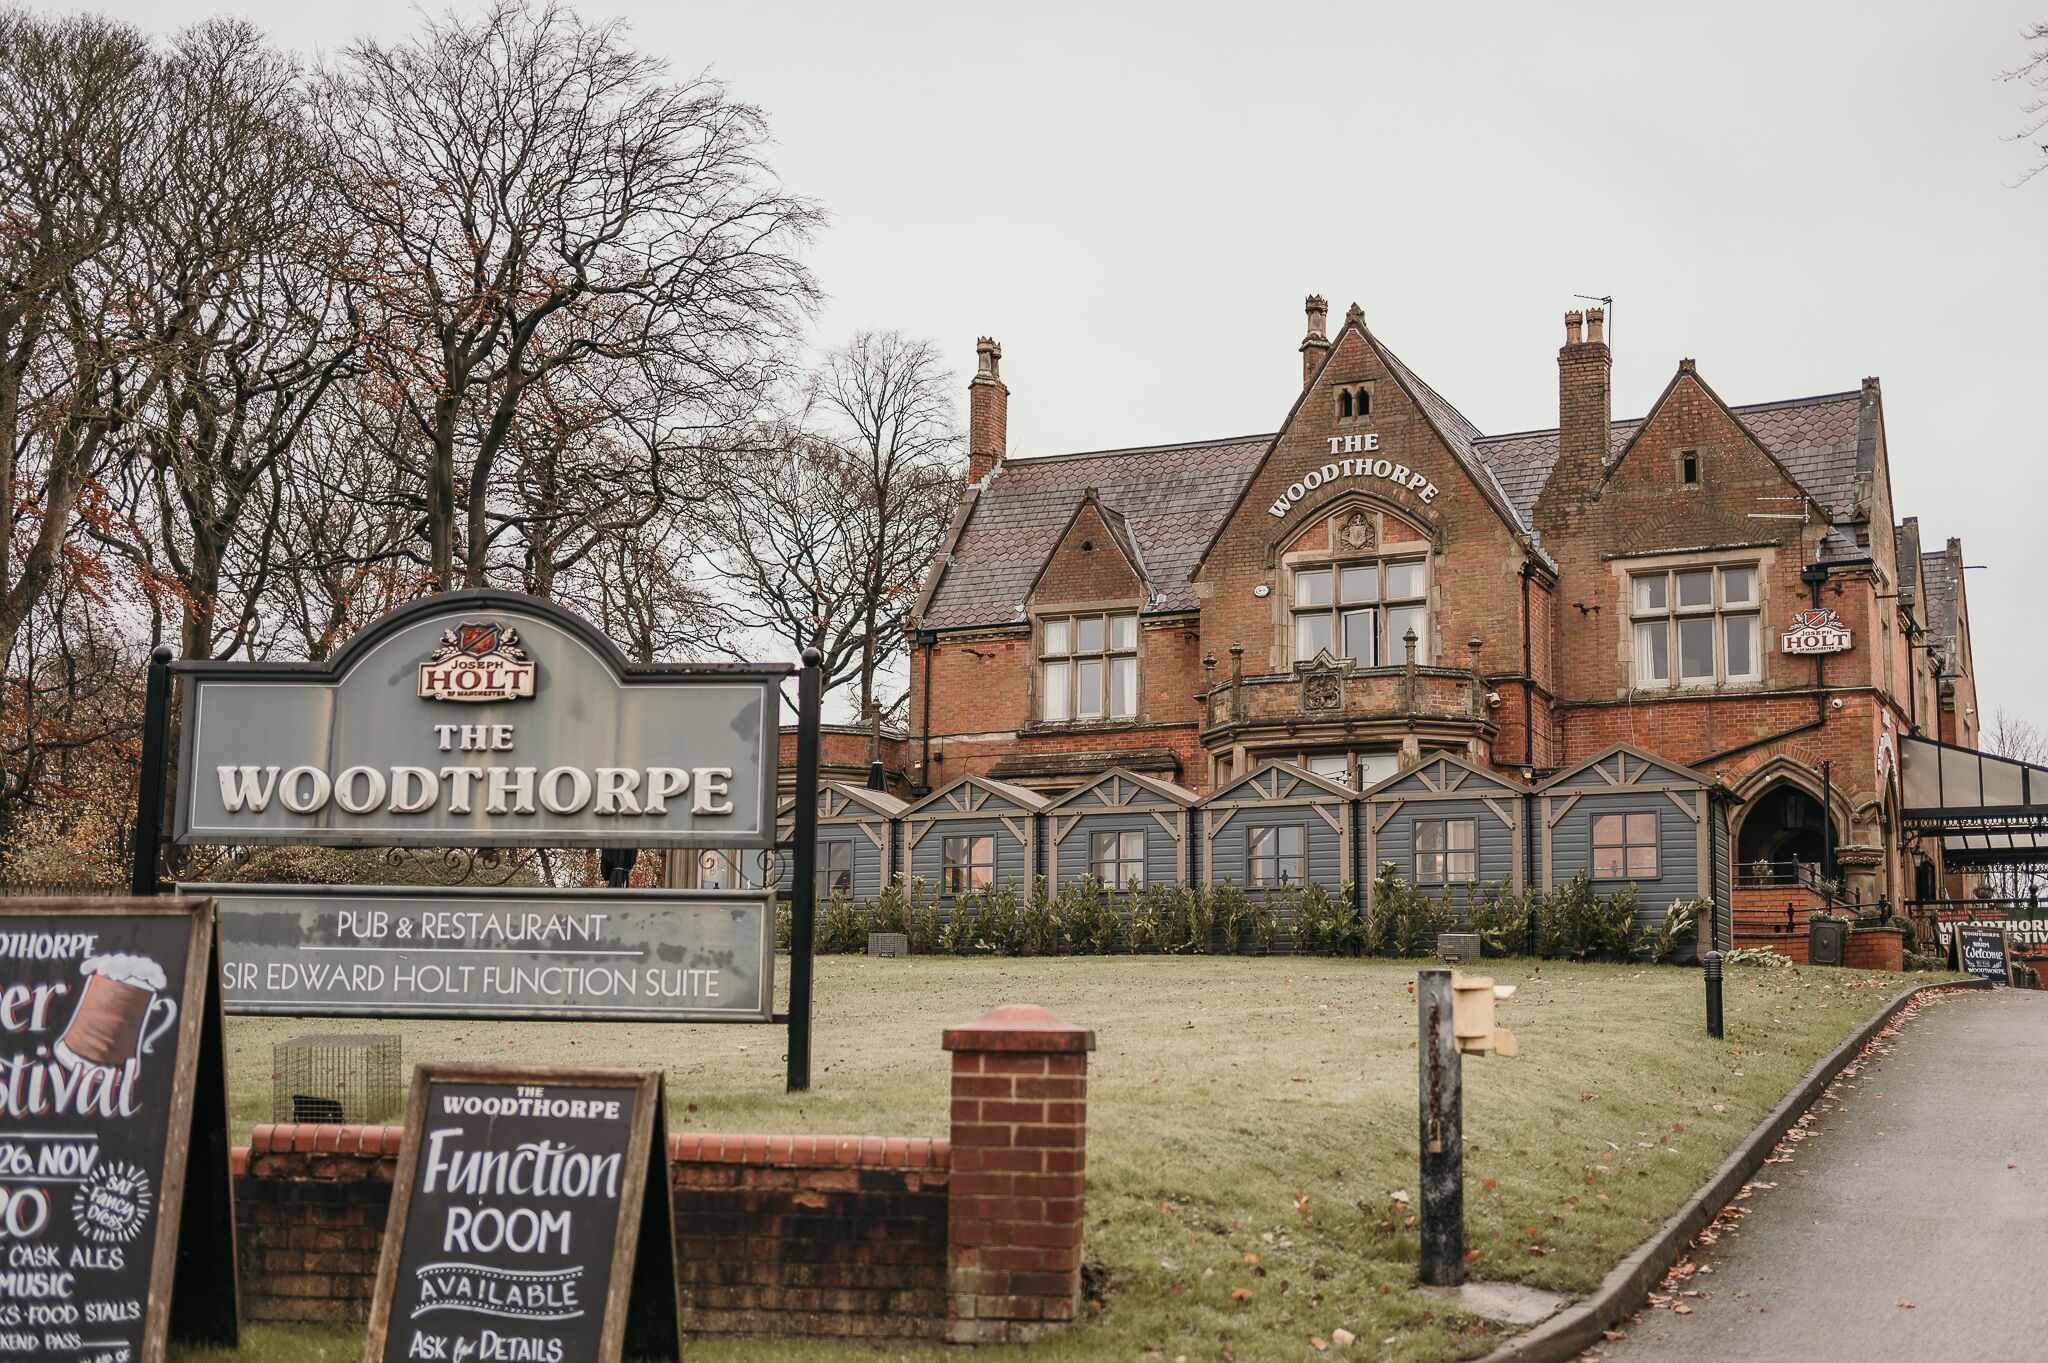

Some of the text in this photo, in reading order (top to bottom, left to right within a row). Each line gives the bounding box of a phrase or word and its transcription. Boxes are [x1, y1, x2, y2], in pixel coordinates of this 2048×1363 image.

[1327, 433, 1379, 454] THE
[1268, 458, 1440, 518] WOODTHORPE
[1787, 635, 1848, 648] HOLT
[451, 660, 504, 670] JOSEPH
[426, 669, 529, 690] HOLT
[433, 724, 515, 752] THE
[216, 765, 734, 816] WOODTHORPE
[337, 910, 607, 941] PUB & RESTAURANT
[1963, 945, 2004, 960] Welcome
[223, 962, 719, 997] SIR EDWARD HOLT FUNCTION SUITE
[516, 1086, 544, 1098] THE
[443, 1095, 621, 1119] WOODTHORPE
[38, 1144, 99, 1175] NOV
[423, 1128, 622, 1198] Function
[90, 1187, 135, 1223] Fancy
[443, 1206, 571, 1254] ROOM
[9, 1245, 60, 1268] CASK
[69, 1246, 125, 1271] ALES
[0, 1272, 75, 1297] MUSIC
[421, 1276, 578, 1307] AVAILABLE
[29, 1304, 79, 1325] FOOD
[85, 1301, 141, 1323] STALLS
[45, 1333, 82, 1350] PASS
[409, 1329, 563, 1363] ASK for DETAILS
